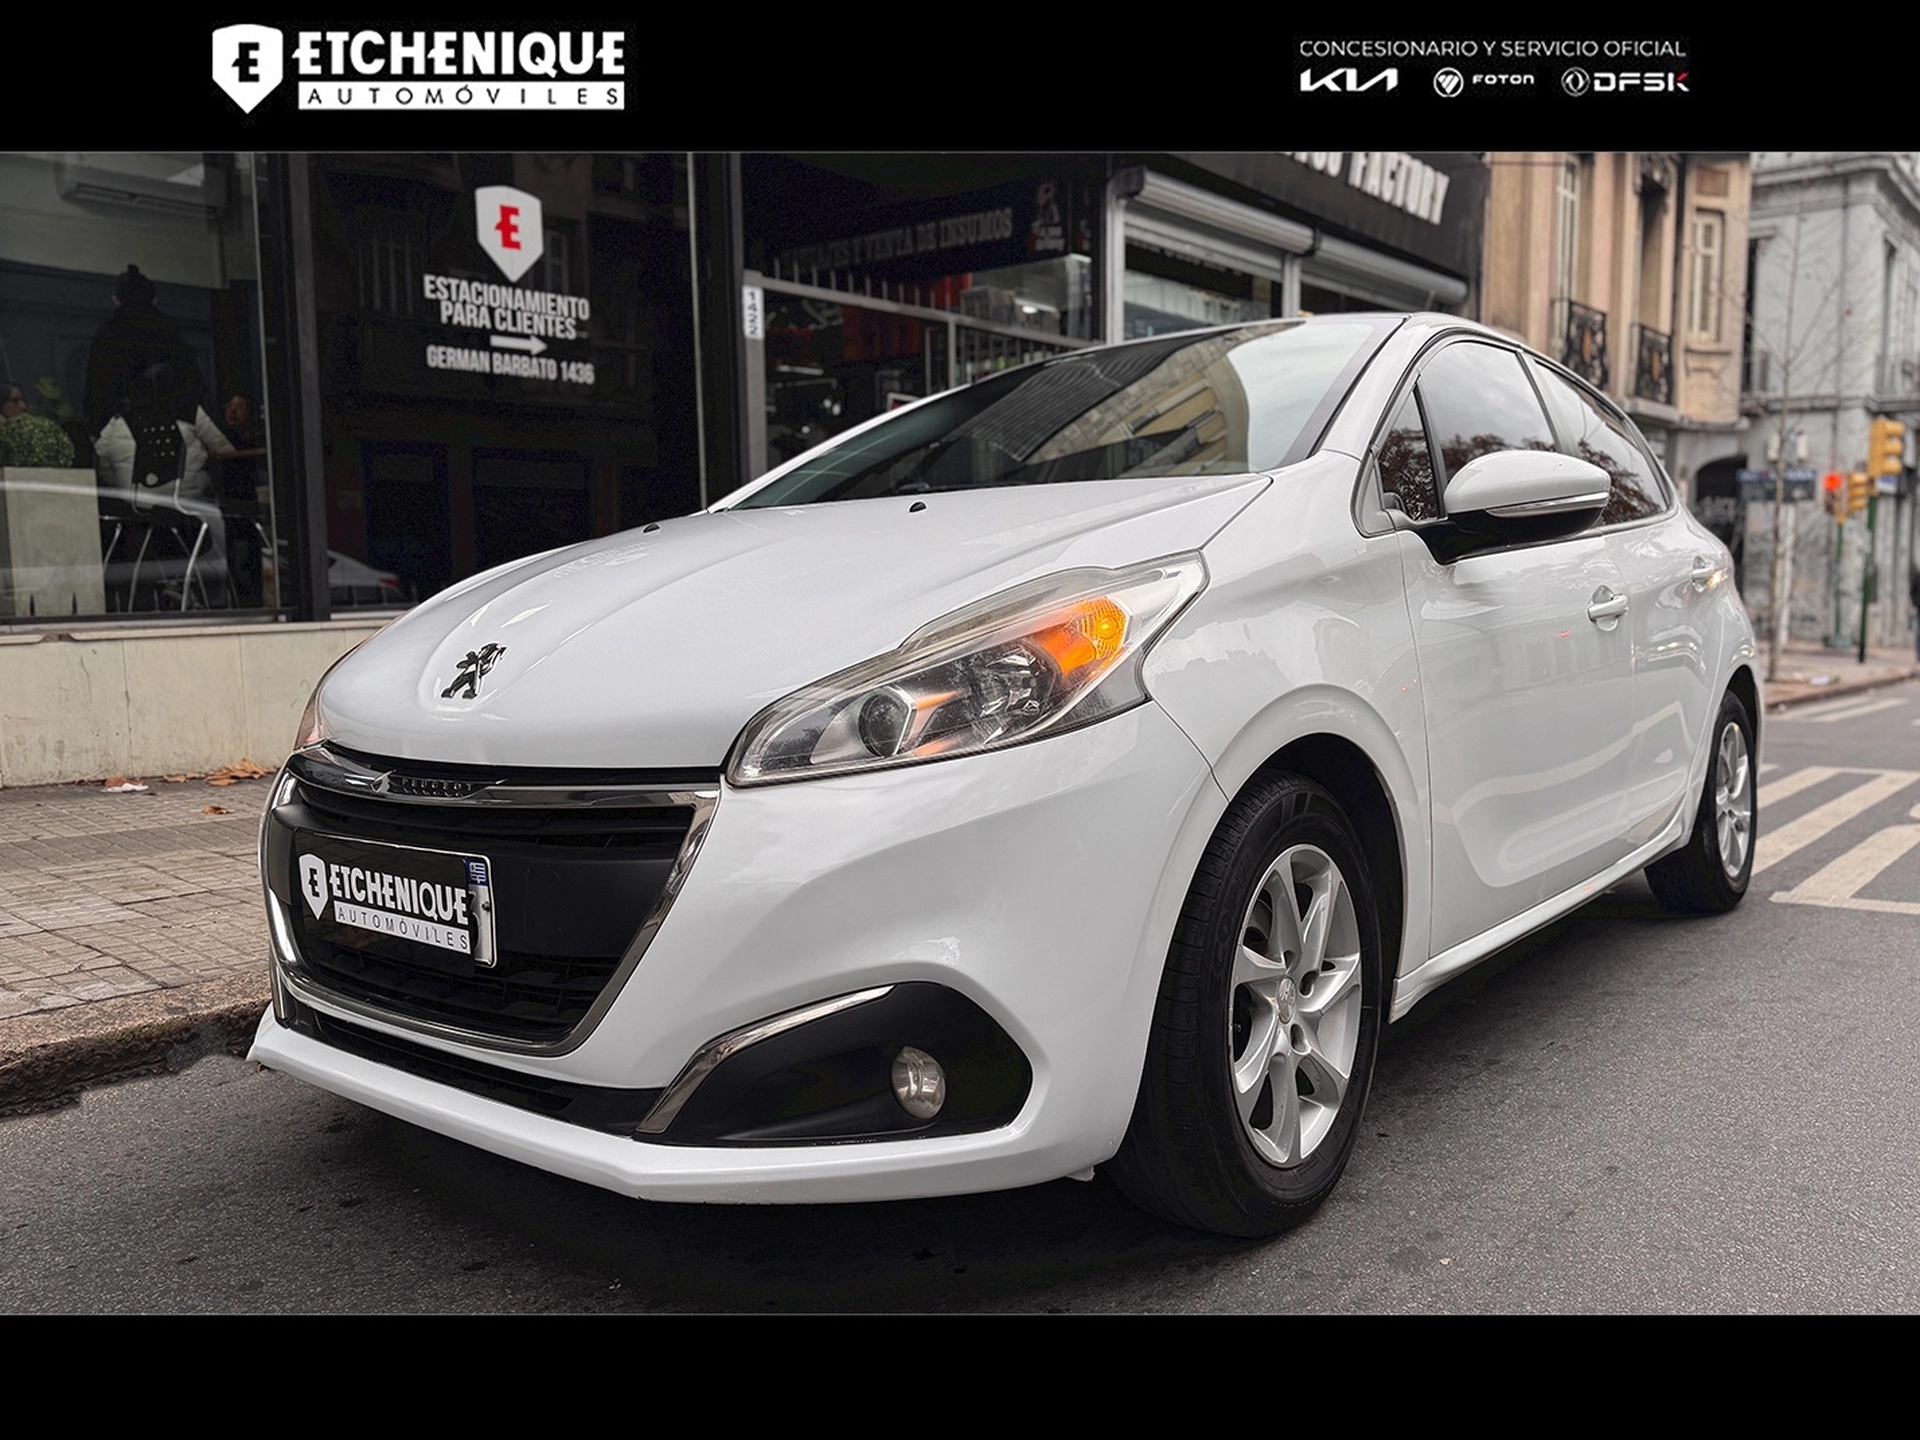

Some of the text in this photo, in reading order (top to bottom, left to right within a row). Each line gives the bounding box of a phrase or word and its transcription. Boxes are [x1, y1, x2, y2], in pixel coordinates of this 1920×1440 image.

[1348, 152, 1450, 226] FACTORY
[423, 273, 590, 321] ESTACIONAMIENTO
[440, 300, 577, 340] PARA CLIENTES
[426, 344, 595, 385] GERMAN BARBATO 1436
[329, 863, 469, 925] ETCHENIQUE
[337, 906, 468, 950] AUTOMÓVILES
